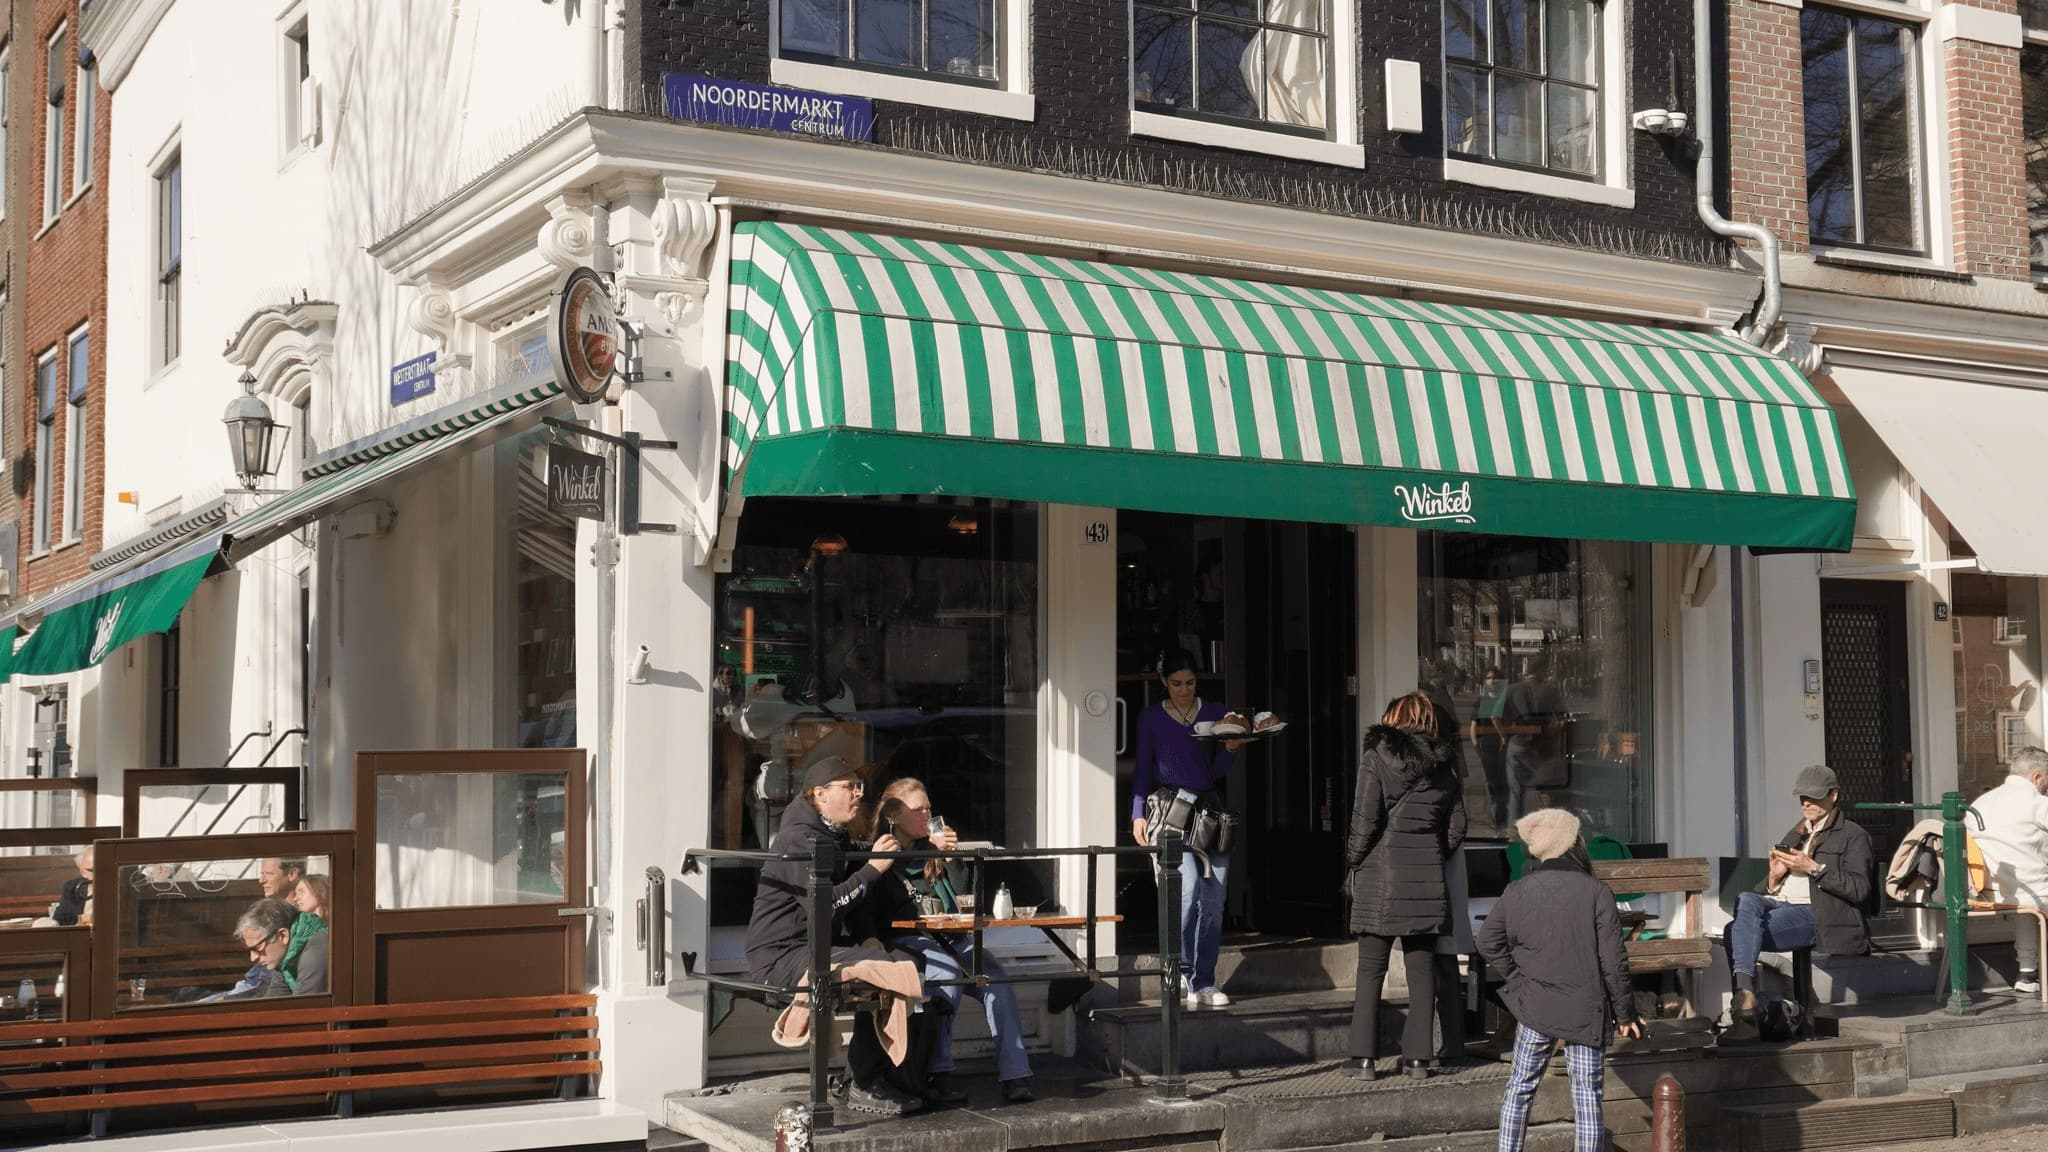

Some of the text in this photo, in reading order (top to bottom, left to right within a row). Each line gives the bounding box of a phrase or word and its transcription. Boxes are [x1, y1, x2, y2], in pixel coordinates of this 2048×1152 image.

[693, 83, 843, 120] NOORDERMARKT
[791, 119, 843, 136] CENTRUM
[552, 463, 601, 501] Winkel
[1394, 481, 1472, 517] Winkel
[1937, 605, 1947, 618] 42
